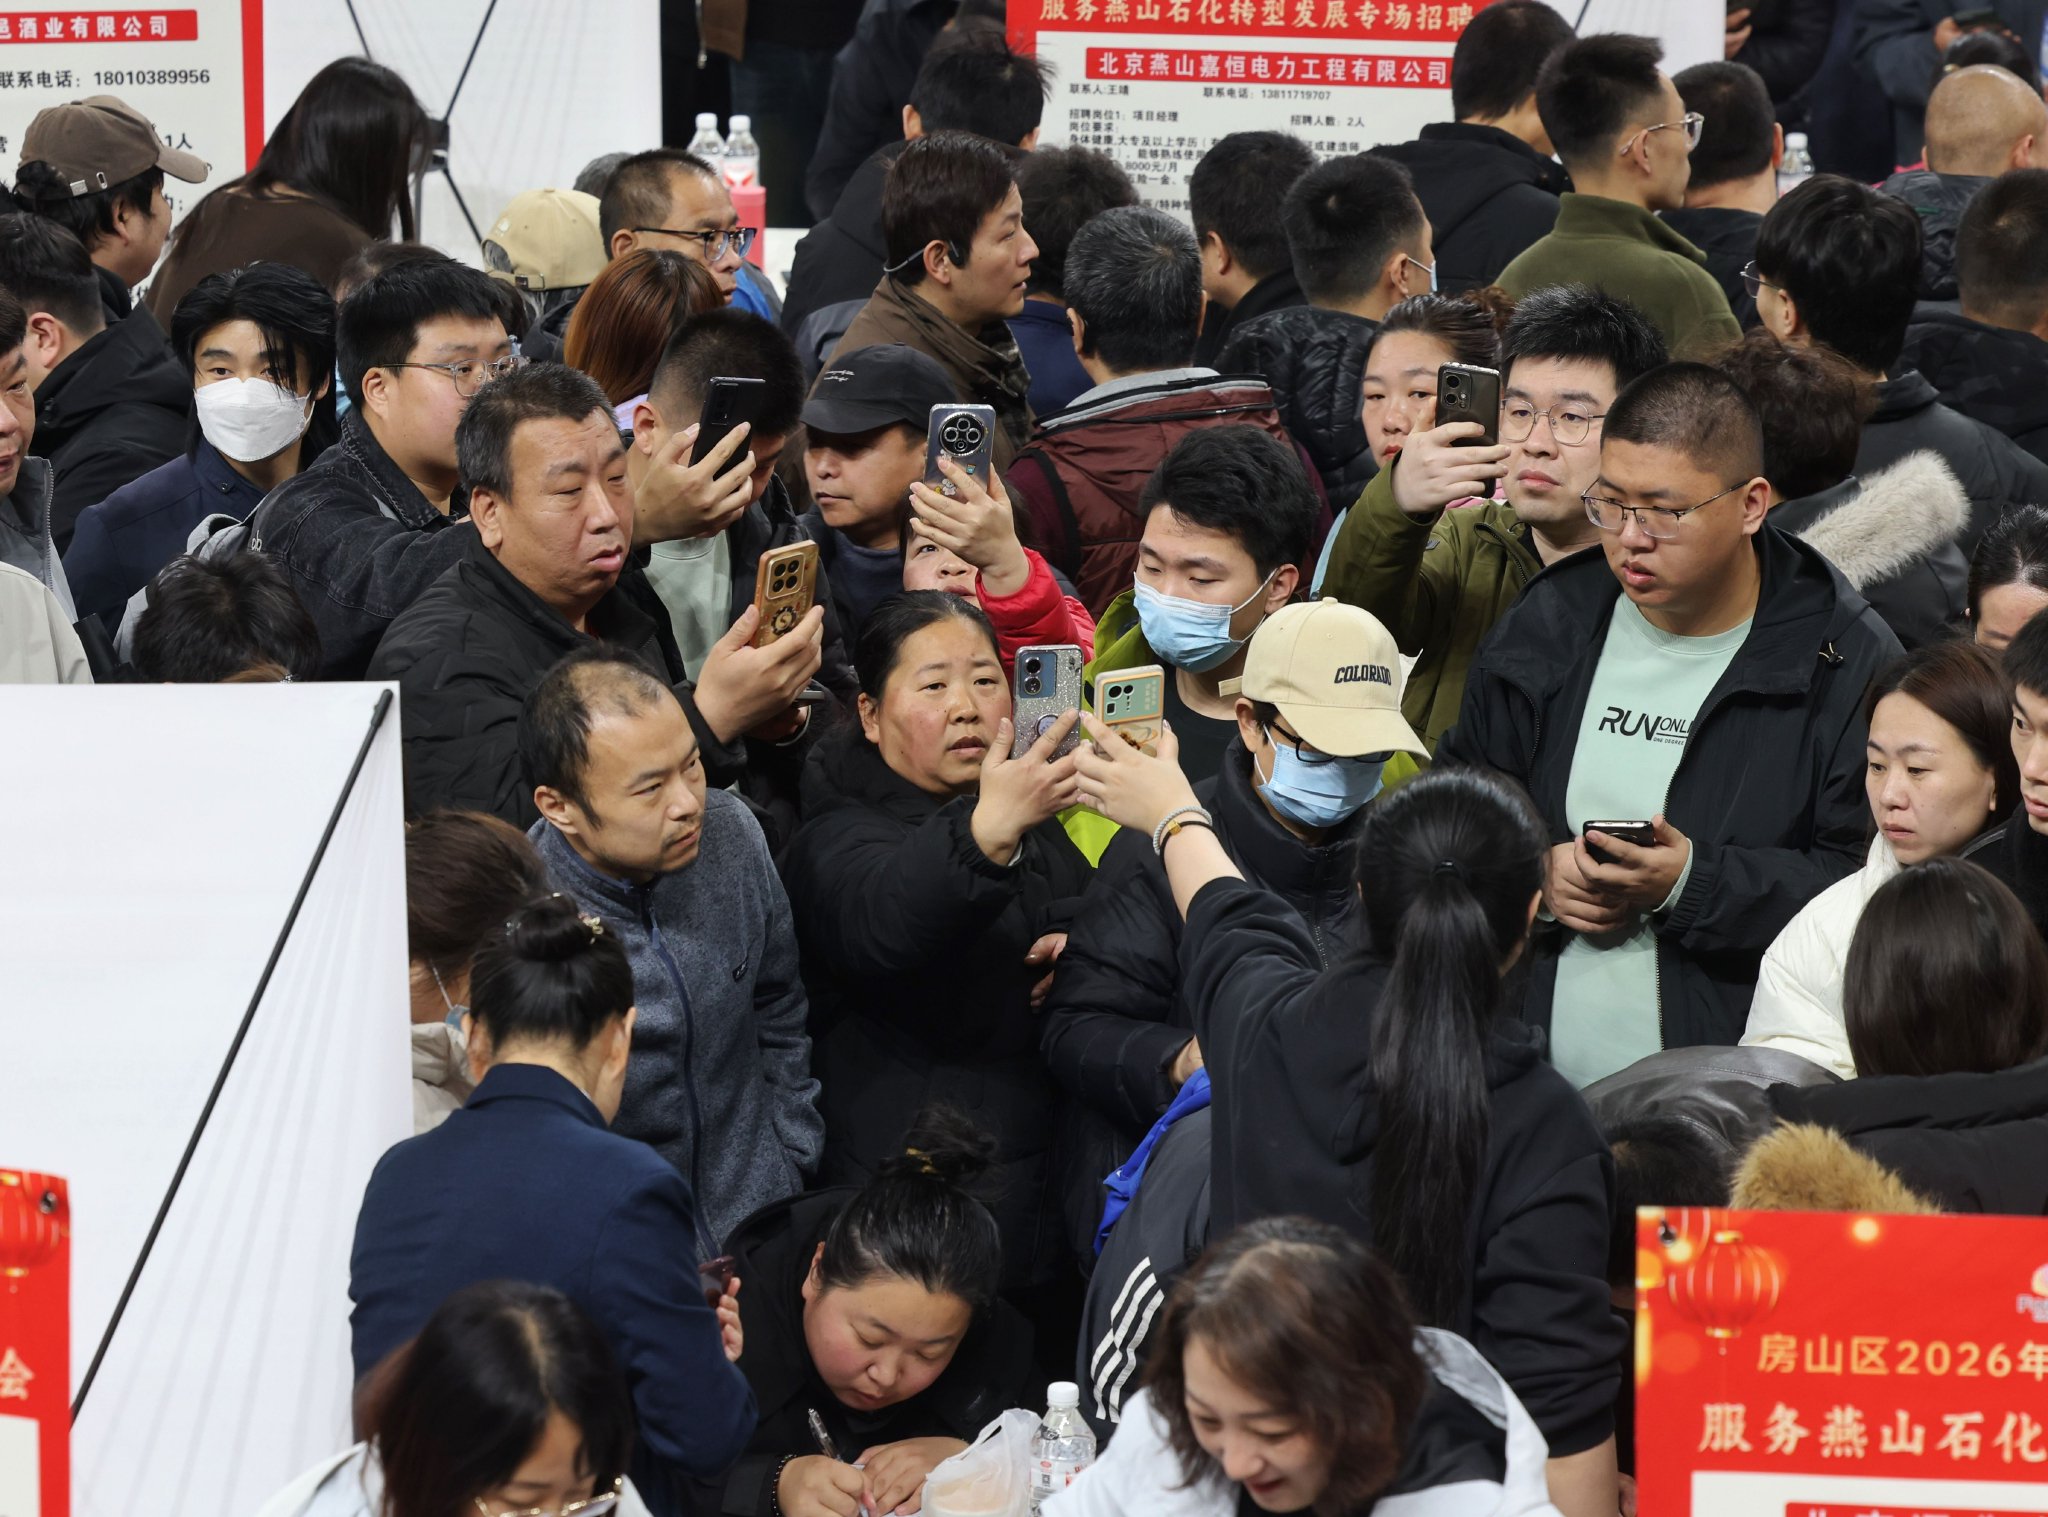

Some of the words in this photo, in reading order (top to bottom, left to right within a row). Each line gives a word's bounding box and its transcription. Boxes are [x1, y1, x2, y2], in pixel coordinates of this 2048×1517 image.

[1099, 52, 1447, 85] 北京燕山嘉恒电力工程有限公司
[1334, 664, 1392, 686] COLORADO
[1599, 706, 1662, 740] RUN
[1757, 1332, 2048, 1382] 房山区2026年
[1699, 1402, 2048, 1463] 服务燕山石化
